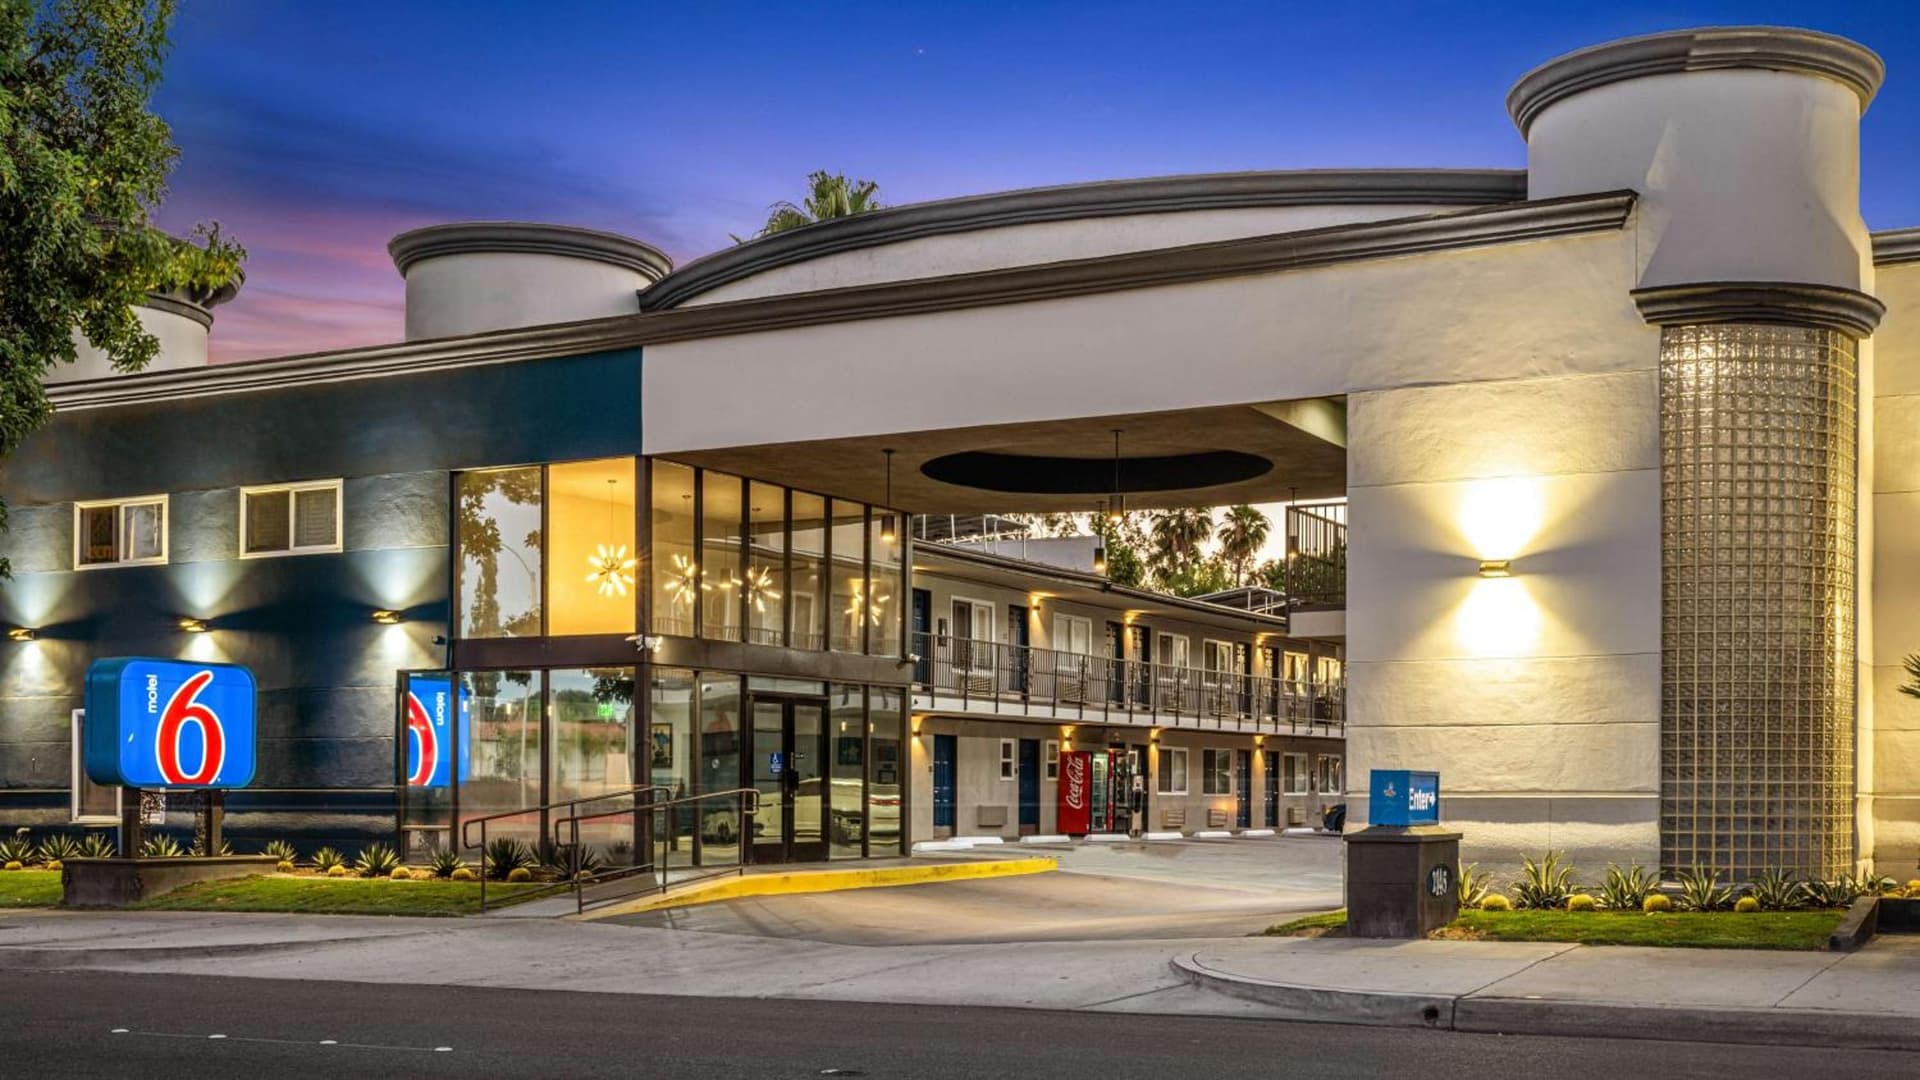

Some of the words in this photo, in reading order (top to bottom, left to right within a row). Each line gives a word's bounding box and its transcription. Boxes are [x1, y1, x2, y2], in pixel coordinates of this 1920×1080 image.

[146, 673, 158, 714] motel
[155, 669, 226, 785] 6
[1409, 788, 1430, 810] Enter
